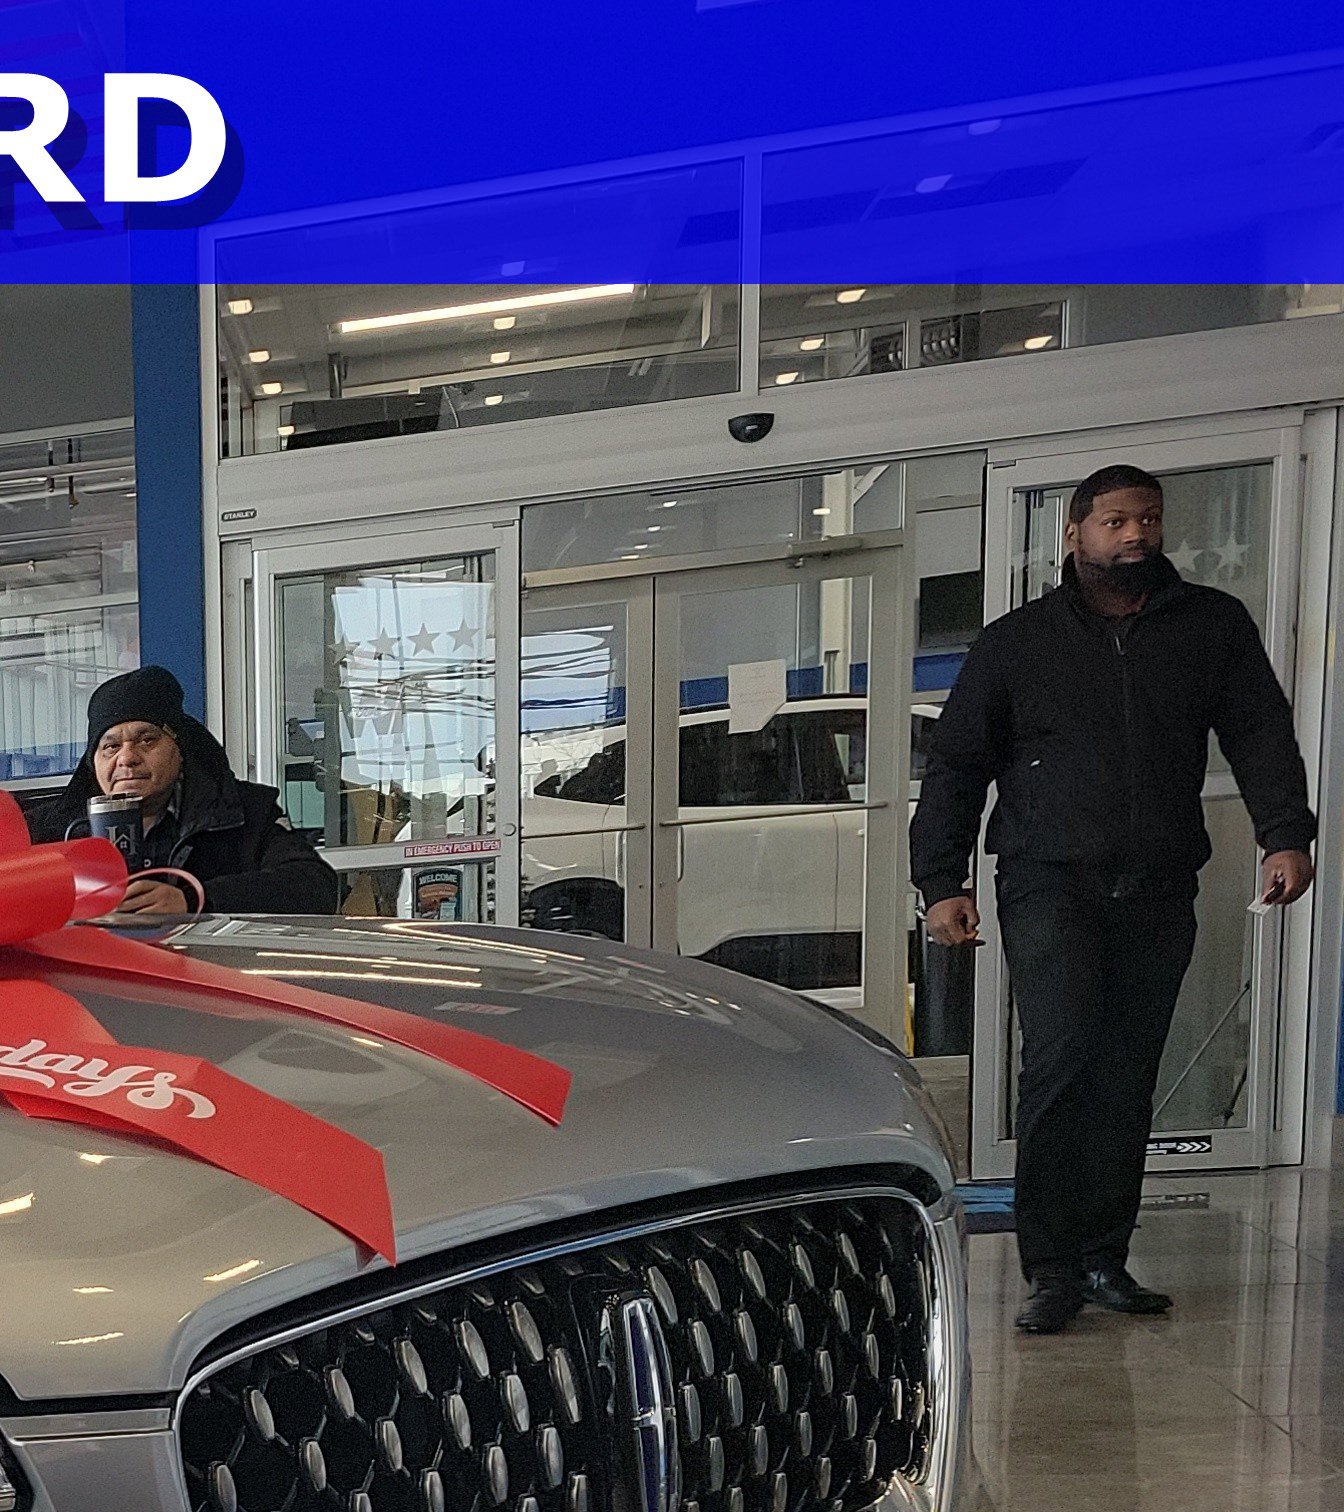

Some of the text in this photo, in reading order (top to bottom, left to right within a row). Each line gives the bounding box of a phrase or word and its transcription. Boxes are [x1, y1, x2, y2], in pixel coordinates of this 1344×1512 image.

[223, 510, 255, 520] STANLEY
[406, 840, 500, 857] IN EMERGENCY PUSH TO OPEN
[419, 873, 458, 884] WELCOME
